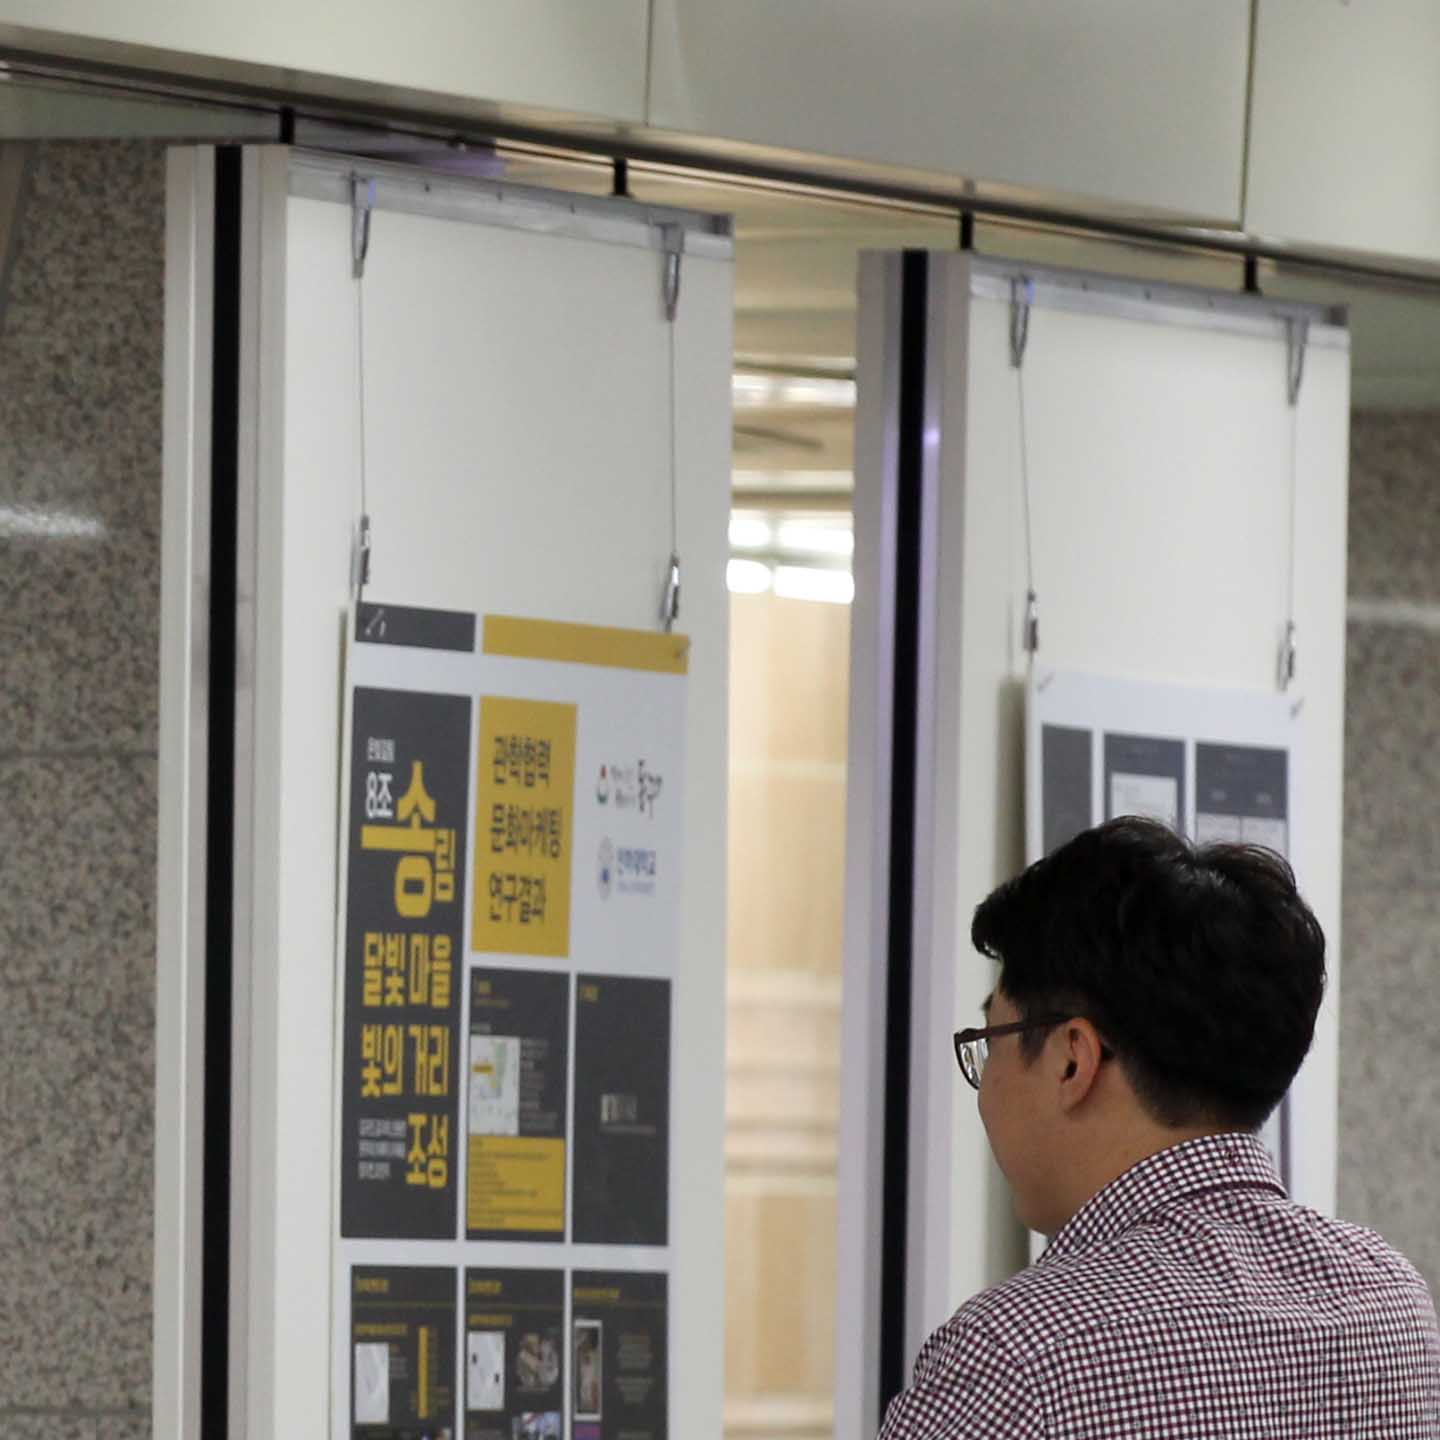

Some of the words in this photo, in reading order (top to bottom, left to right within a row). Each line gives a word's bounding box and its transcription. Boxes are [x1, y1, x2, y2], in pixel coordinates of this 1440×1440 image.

[494, 734, 551, 789] 관학협력
[366, 772, 393, 818] 8조
[492, 803, 561, 859] 문화마케팅
[489, 871, 546, 924] 연구결과
[363, 933, 405, 1007] 달빛
[410, 934, 451, 1008] 마을
[361, 1024, 403, 1097] 빛의
[409, 1026, 450, 1097] 거리
[406, 1114, 448, 1189] 조성
